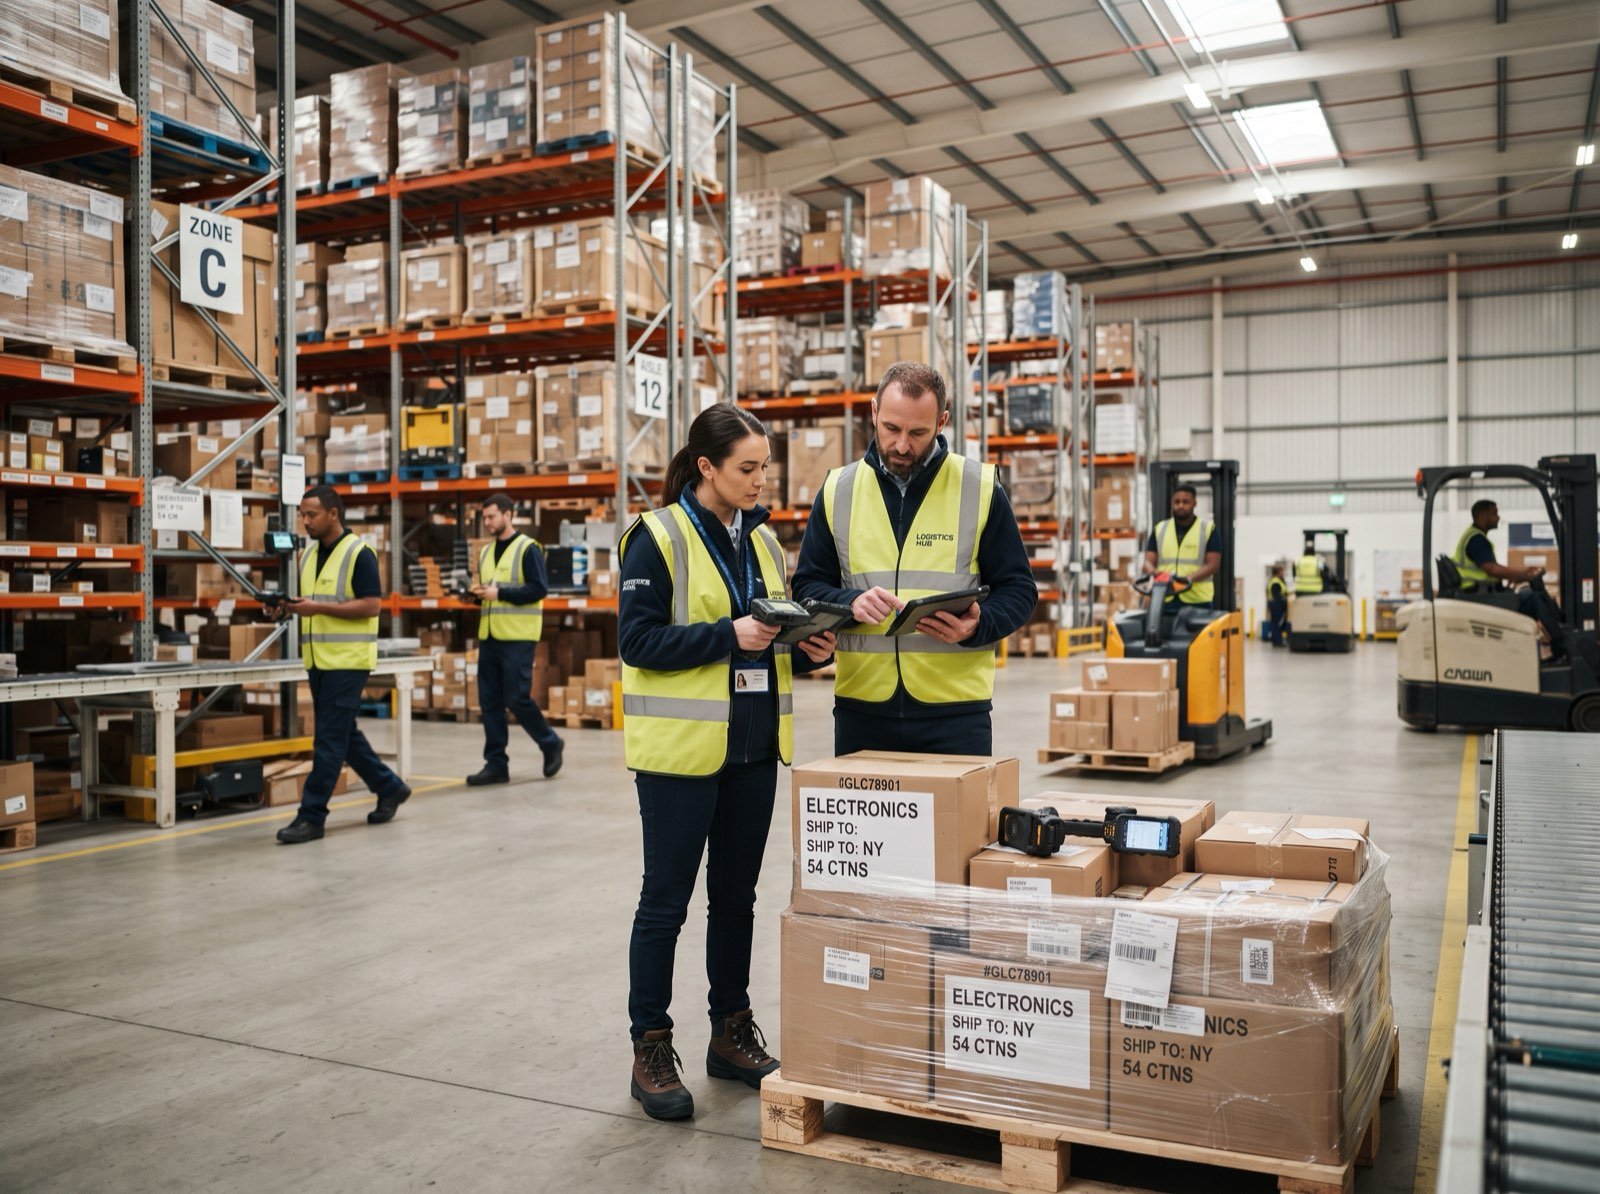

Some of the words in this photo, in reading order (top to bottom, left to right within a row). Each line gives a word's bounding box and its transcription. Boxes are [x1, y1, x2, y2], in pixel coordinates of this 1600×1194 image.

[190, 216, 233, 244] ZONE
[199, 247, 226, 298] C
[640, 378, 662, 410] 12
[916, 533, 954, 542] LOGISTICS
[806, 797, 919, 819] ELECTRONICS
[806, 820, 834, 834] SHIP
[837, 821, 858, 836] TO:
[806, 839, 835, 853] SHIP
[837, 841, 859, 855] TO:
[863, 841, 884, 857] NY
[807, 858, 824, 874] 54
[828, 860, 868, 878] CTNS
[983, 965, 1052, 985] #GLC78901
[952, 988, 1074, 1018] ELECTRONICS
[952, 1014, 982, 1031] SHIP
[986, 1018, 1009, 1035] TO:
[1013, 1021, 1035, 1039] NY
[952, 1035, 969, 1052] 54
[974, 1037, 1017, 1059] CTNS
[1123, 1037, 1156, 1055] SHIP
[1160, 1041, 1186, 1060] TO:
[1190, 1044, 1213, 1063] NY
[1122, 1059, 1142, 1077] 54
[1146, 1062, 1194, 1084] CTNS
